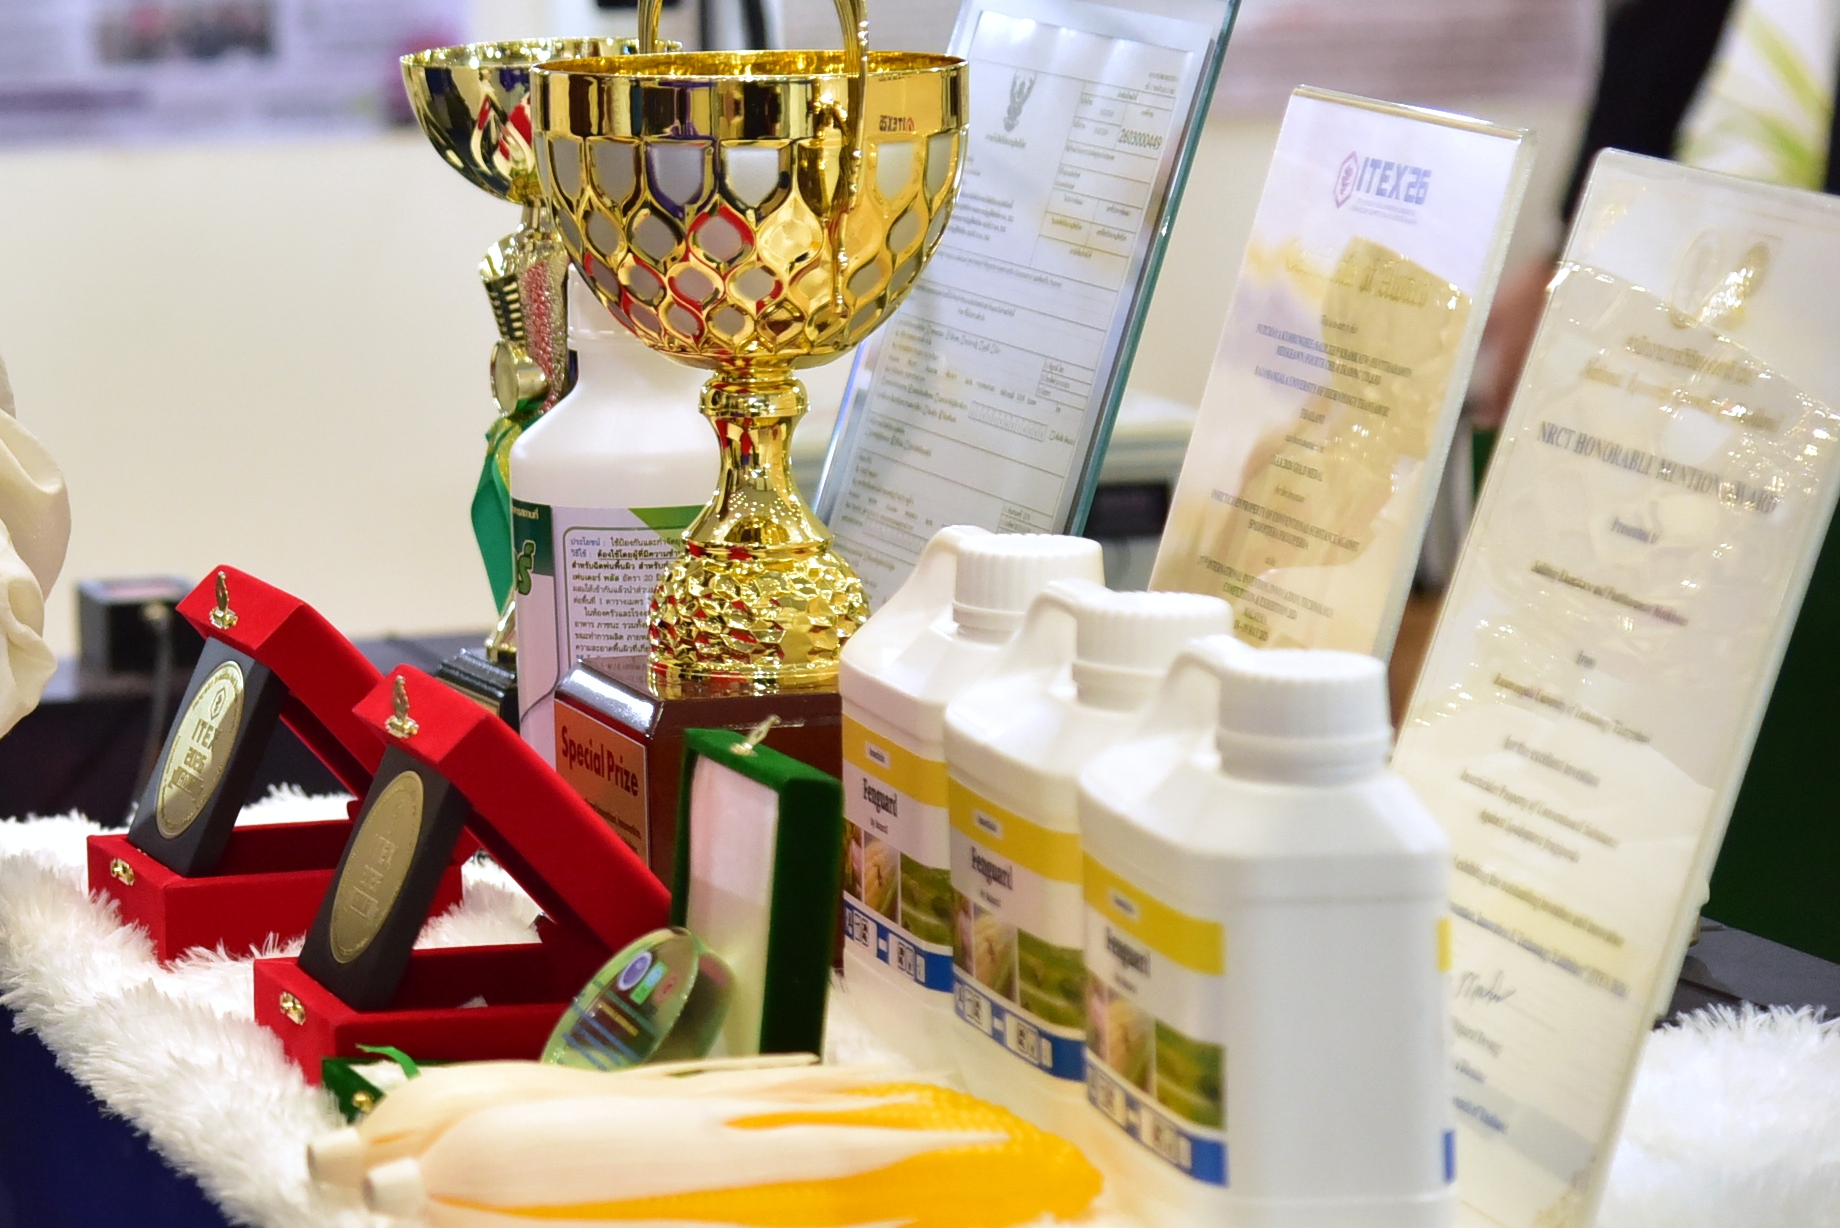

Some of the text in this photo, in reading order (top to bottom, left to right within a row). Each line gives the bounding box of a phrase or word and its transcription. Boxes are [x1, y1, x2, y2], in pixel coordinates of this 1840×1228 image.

[1534, 419, 1576, 451] NRCT
[570, 536, 600, 547] ประโยชน์
[191, 718, 223, 752] ITEX
[562, 725, 639, 797] Special Prize
[863, 777, 898, 818] Fenguard
